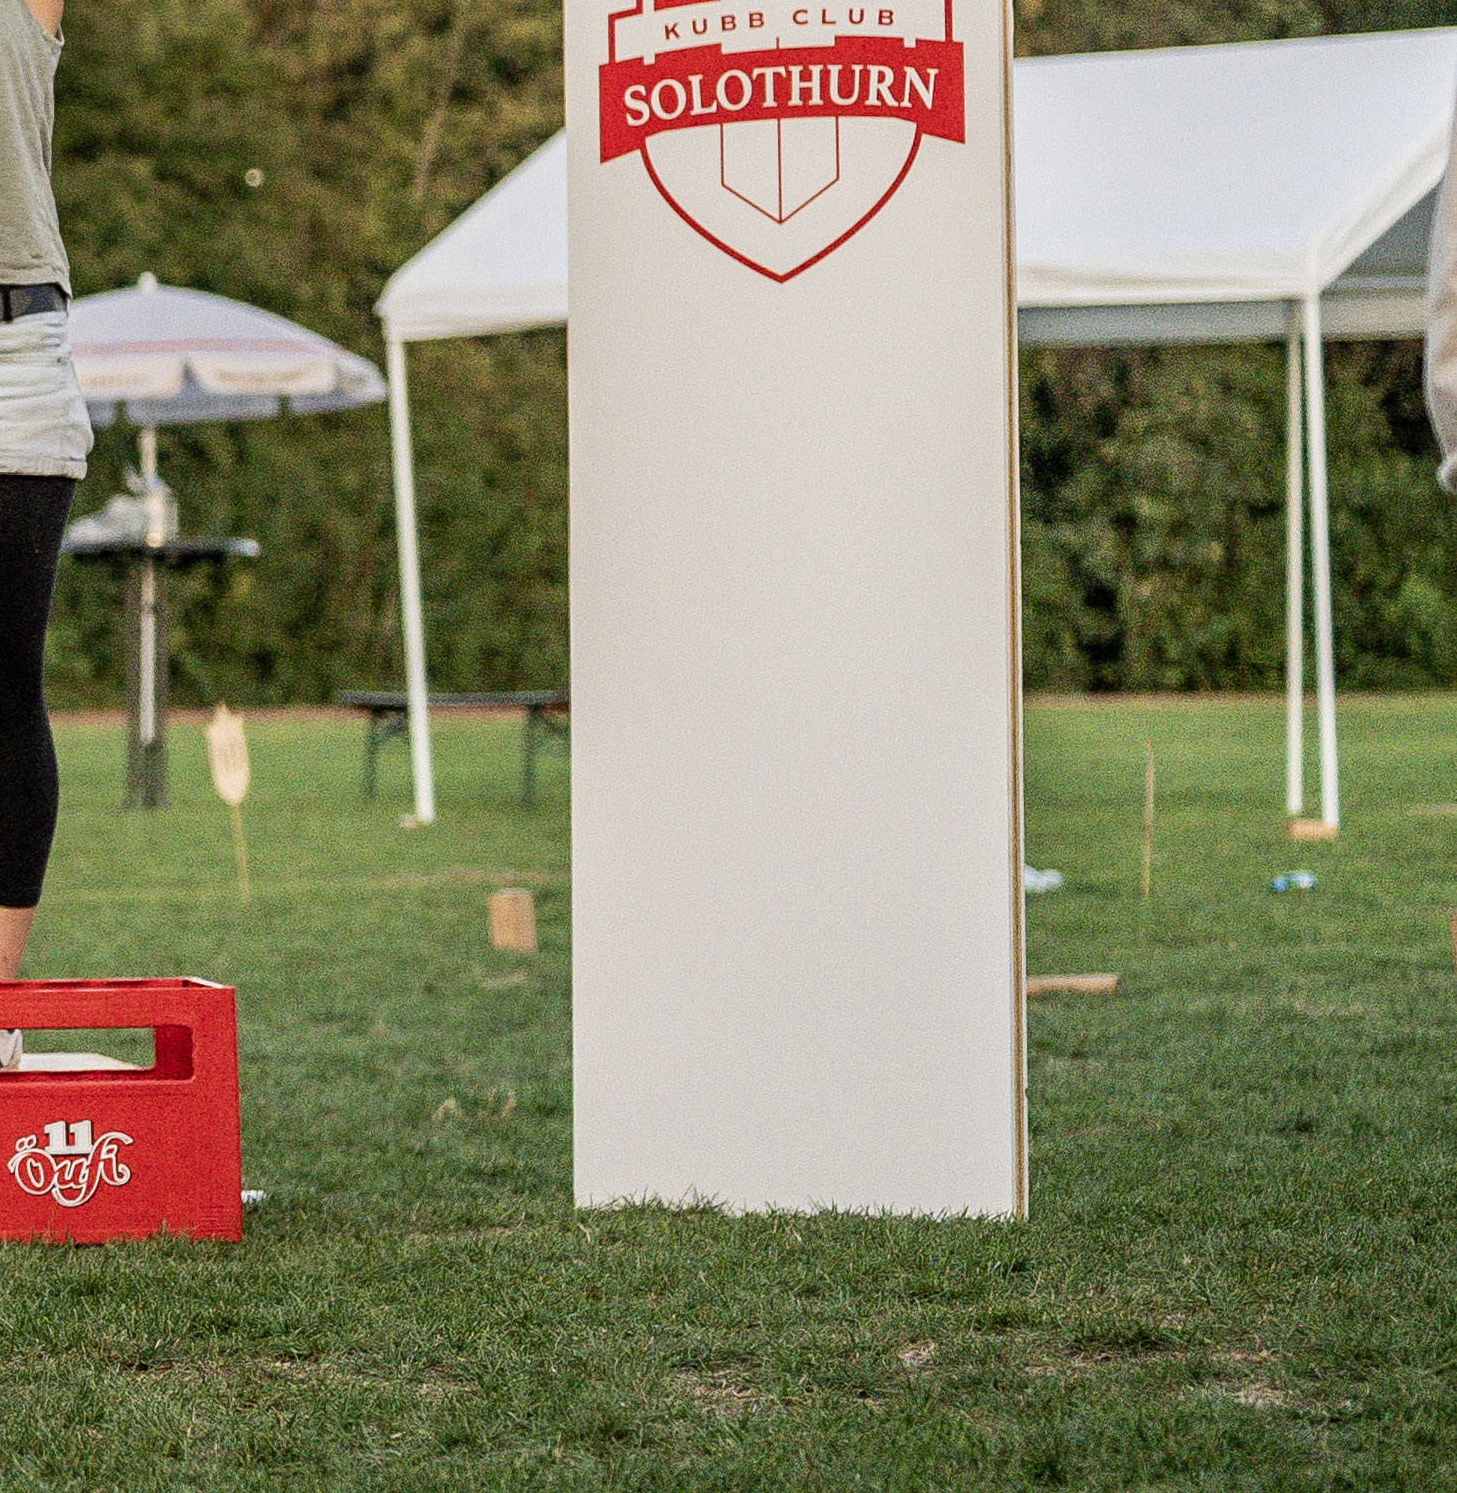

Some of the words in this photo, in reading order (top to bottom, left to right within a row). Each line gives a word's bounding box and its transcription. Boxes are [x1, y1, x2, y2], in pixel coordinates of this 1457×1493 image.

[664, 11, 765, 41] KUBB
[792, 8, 896, 27] CLUB
[623, 63, 939, 127] SOLOTHURN
[44, 1119, 93, 1154] 11
